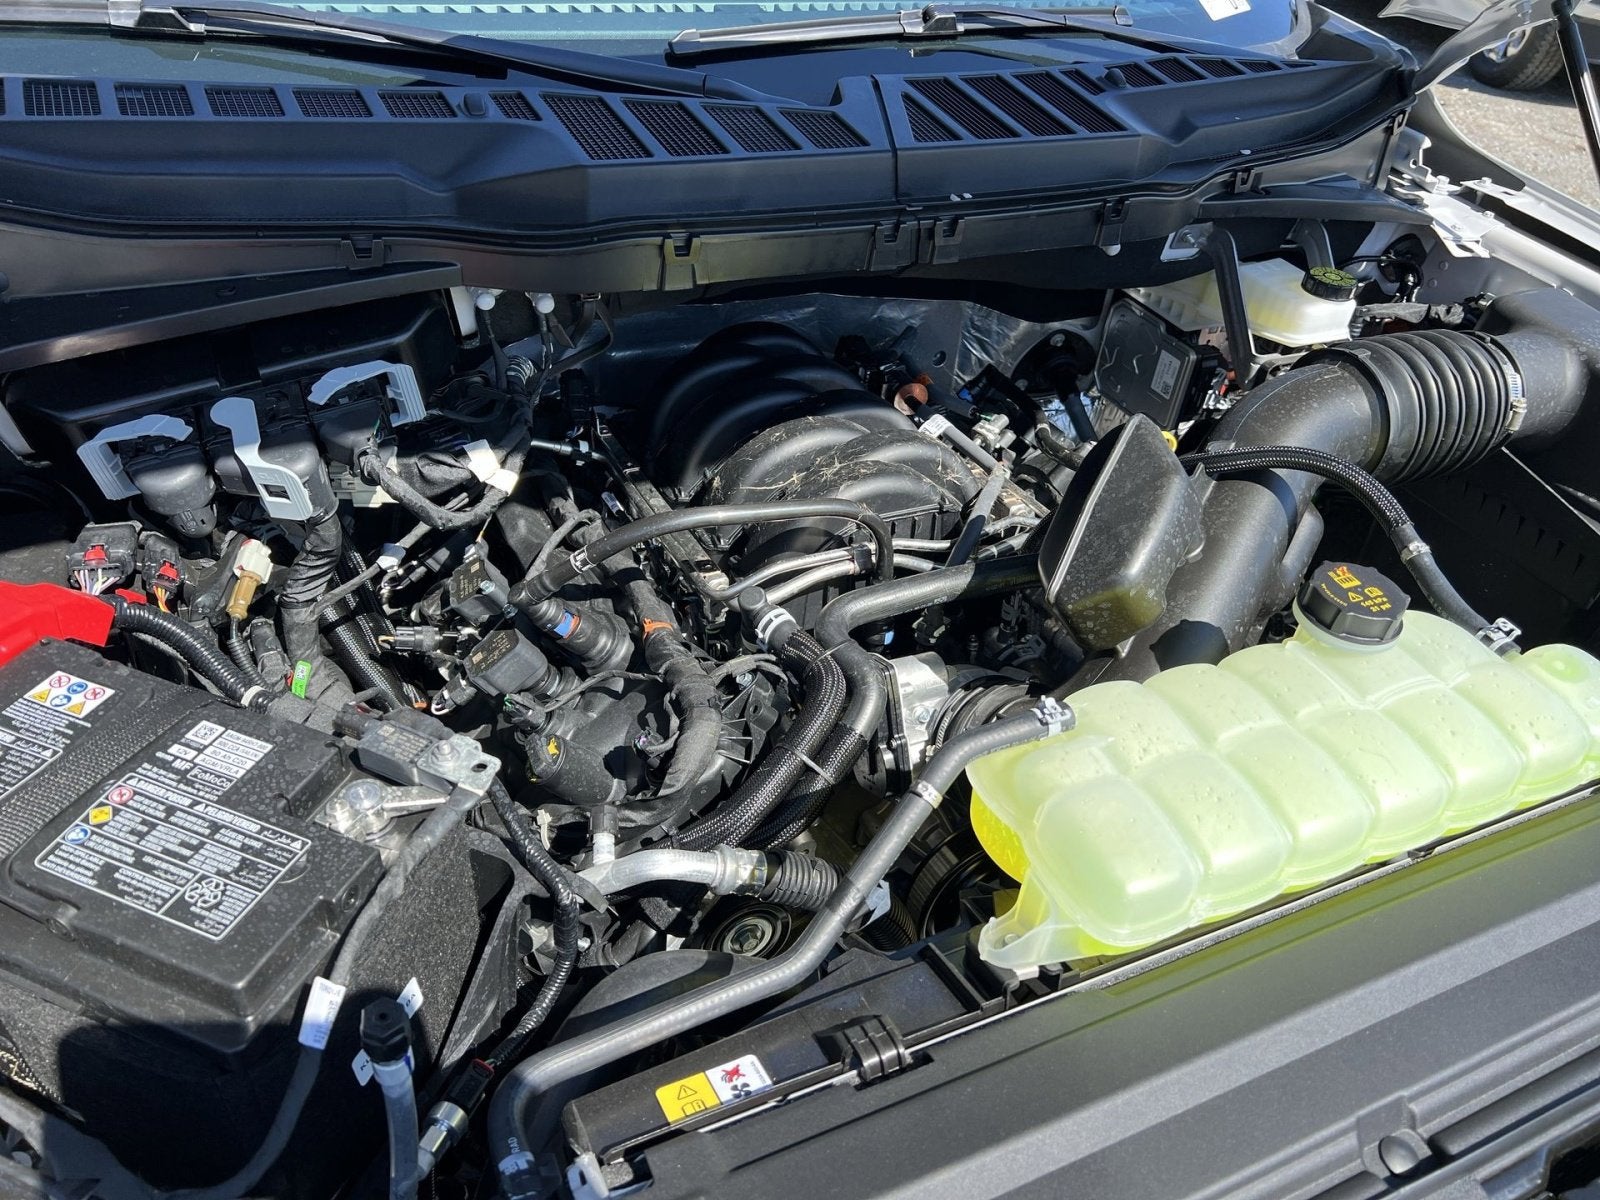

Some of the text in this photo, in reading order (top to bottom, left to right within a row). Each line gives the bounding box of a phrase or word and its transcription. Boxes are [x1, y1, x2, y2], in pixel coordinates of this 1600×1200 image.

[171, 758, 194, 771] MF
[191, 767, 232, 788] FoMoCo
[507, 1136, 520, 1154] RAD
